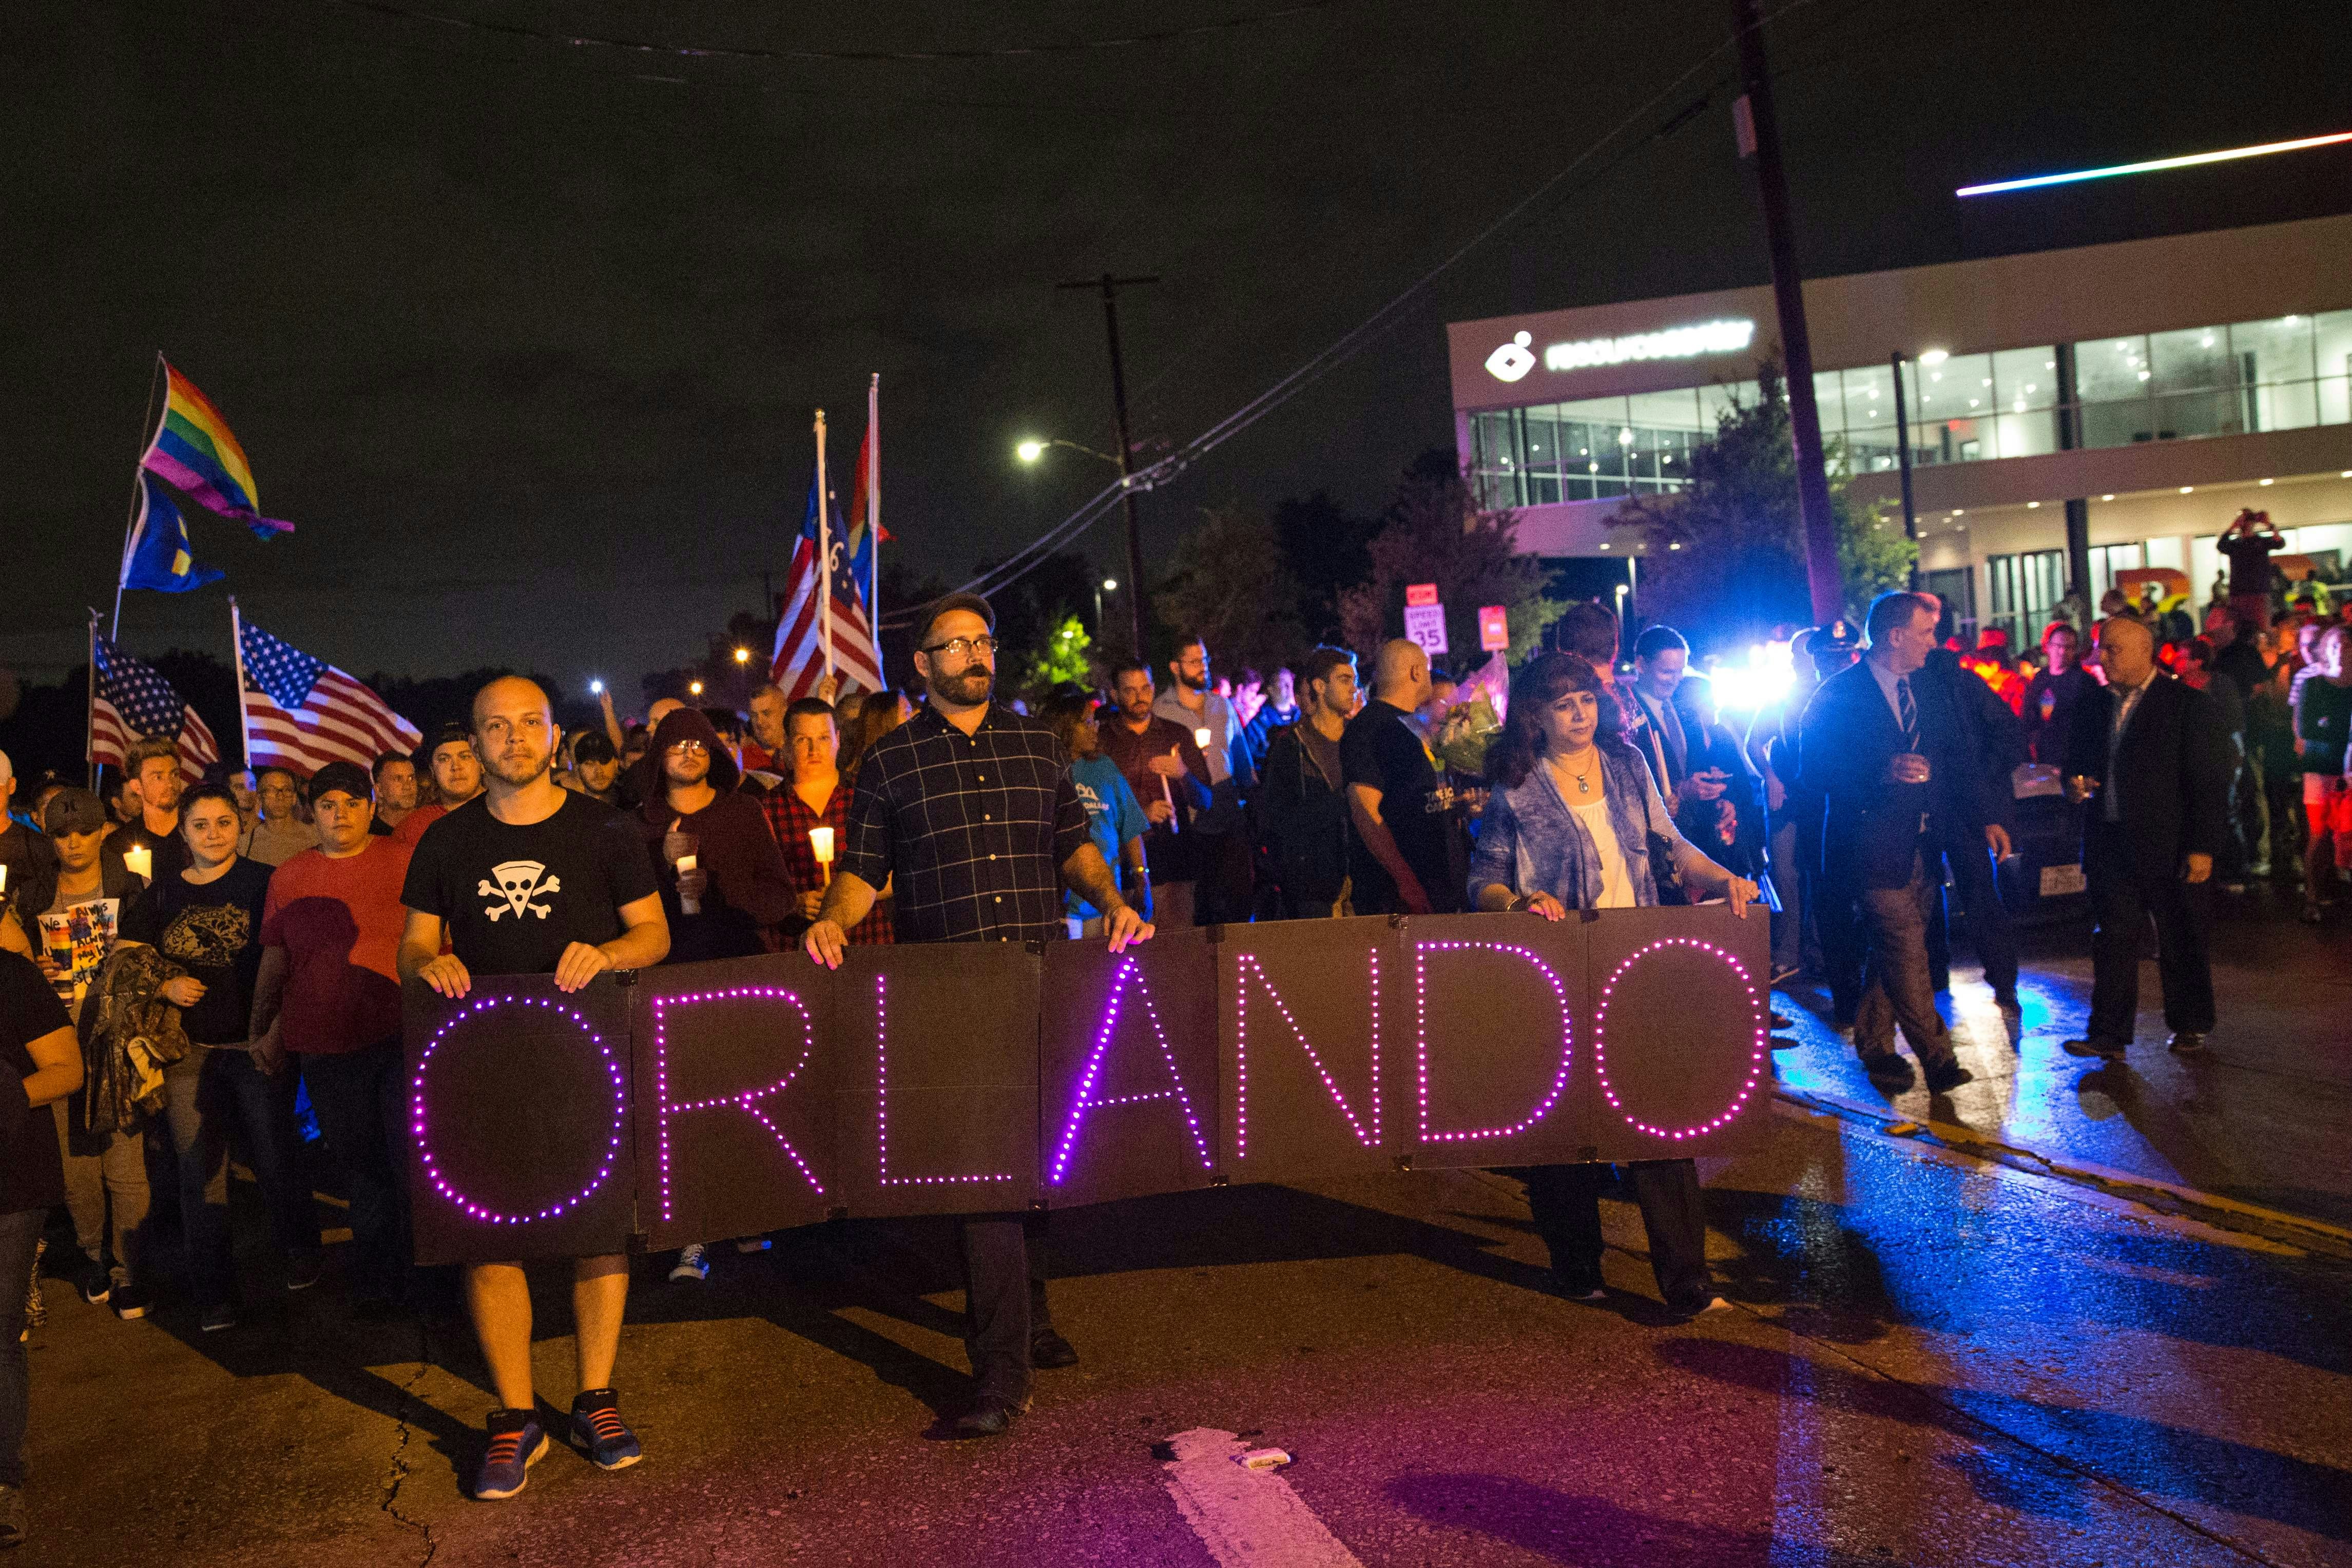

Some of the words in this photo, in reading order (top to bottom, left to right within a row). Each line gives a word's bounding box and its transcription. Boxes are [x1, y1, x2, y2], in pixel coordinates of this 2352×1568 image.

[1410, 610, 1439, 619] SPEED
[1413, 620, 1437, 629] LIMIT
[1414, 629, 1441, 647] 35
[40, 917, 61, 933] We
[412, 938, 1764, 1224] ORLANDO
